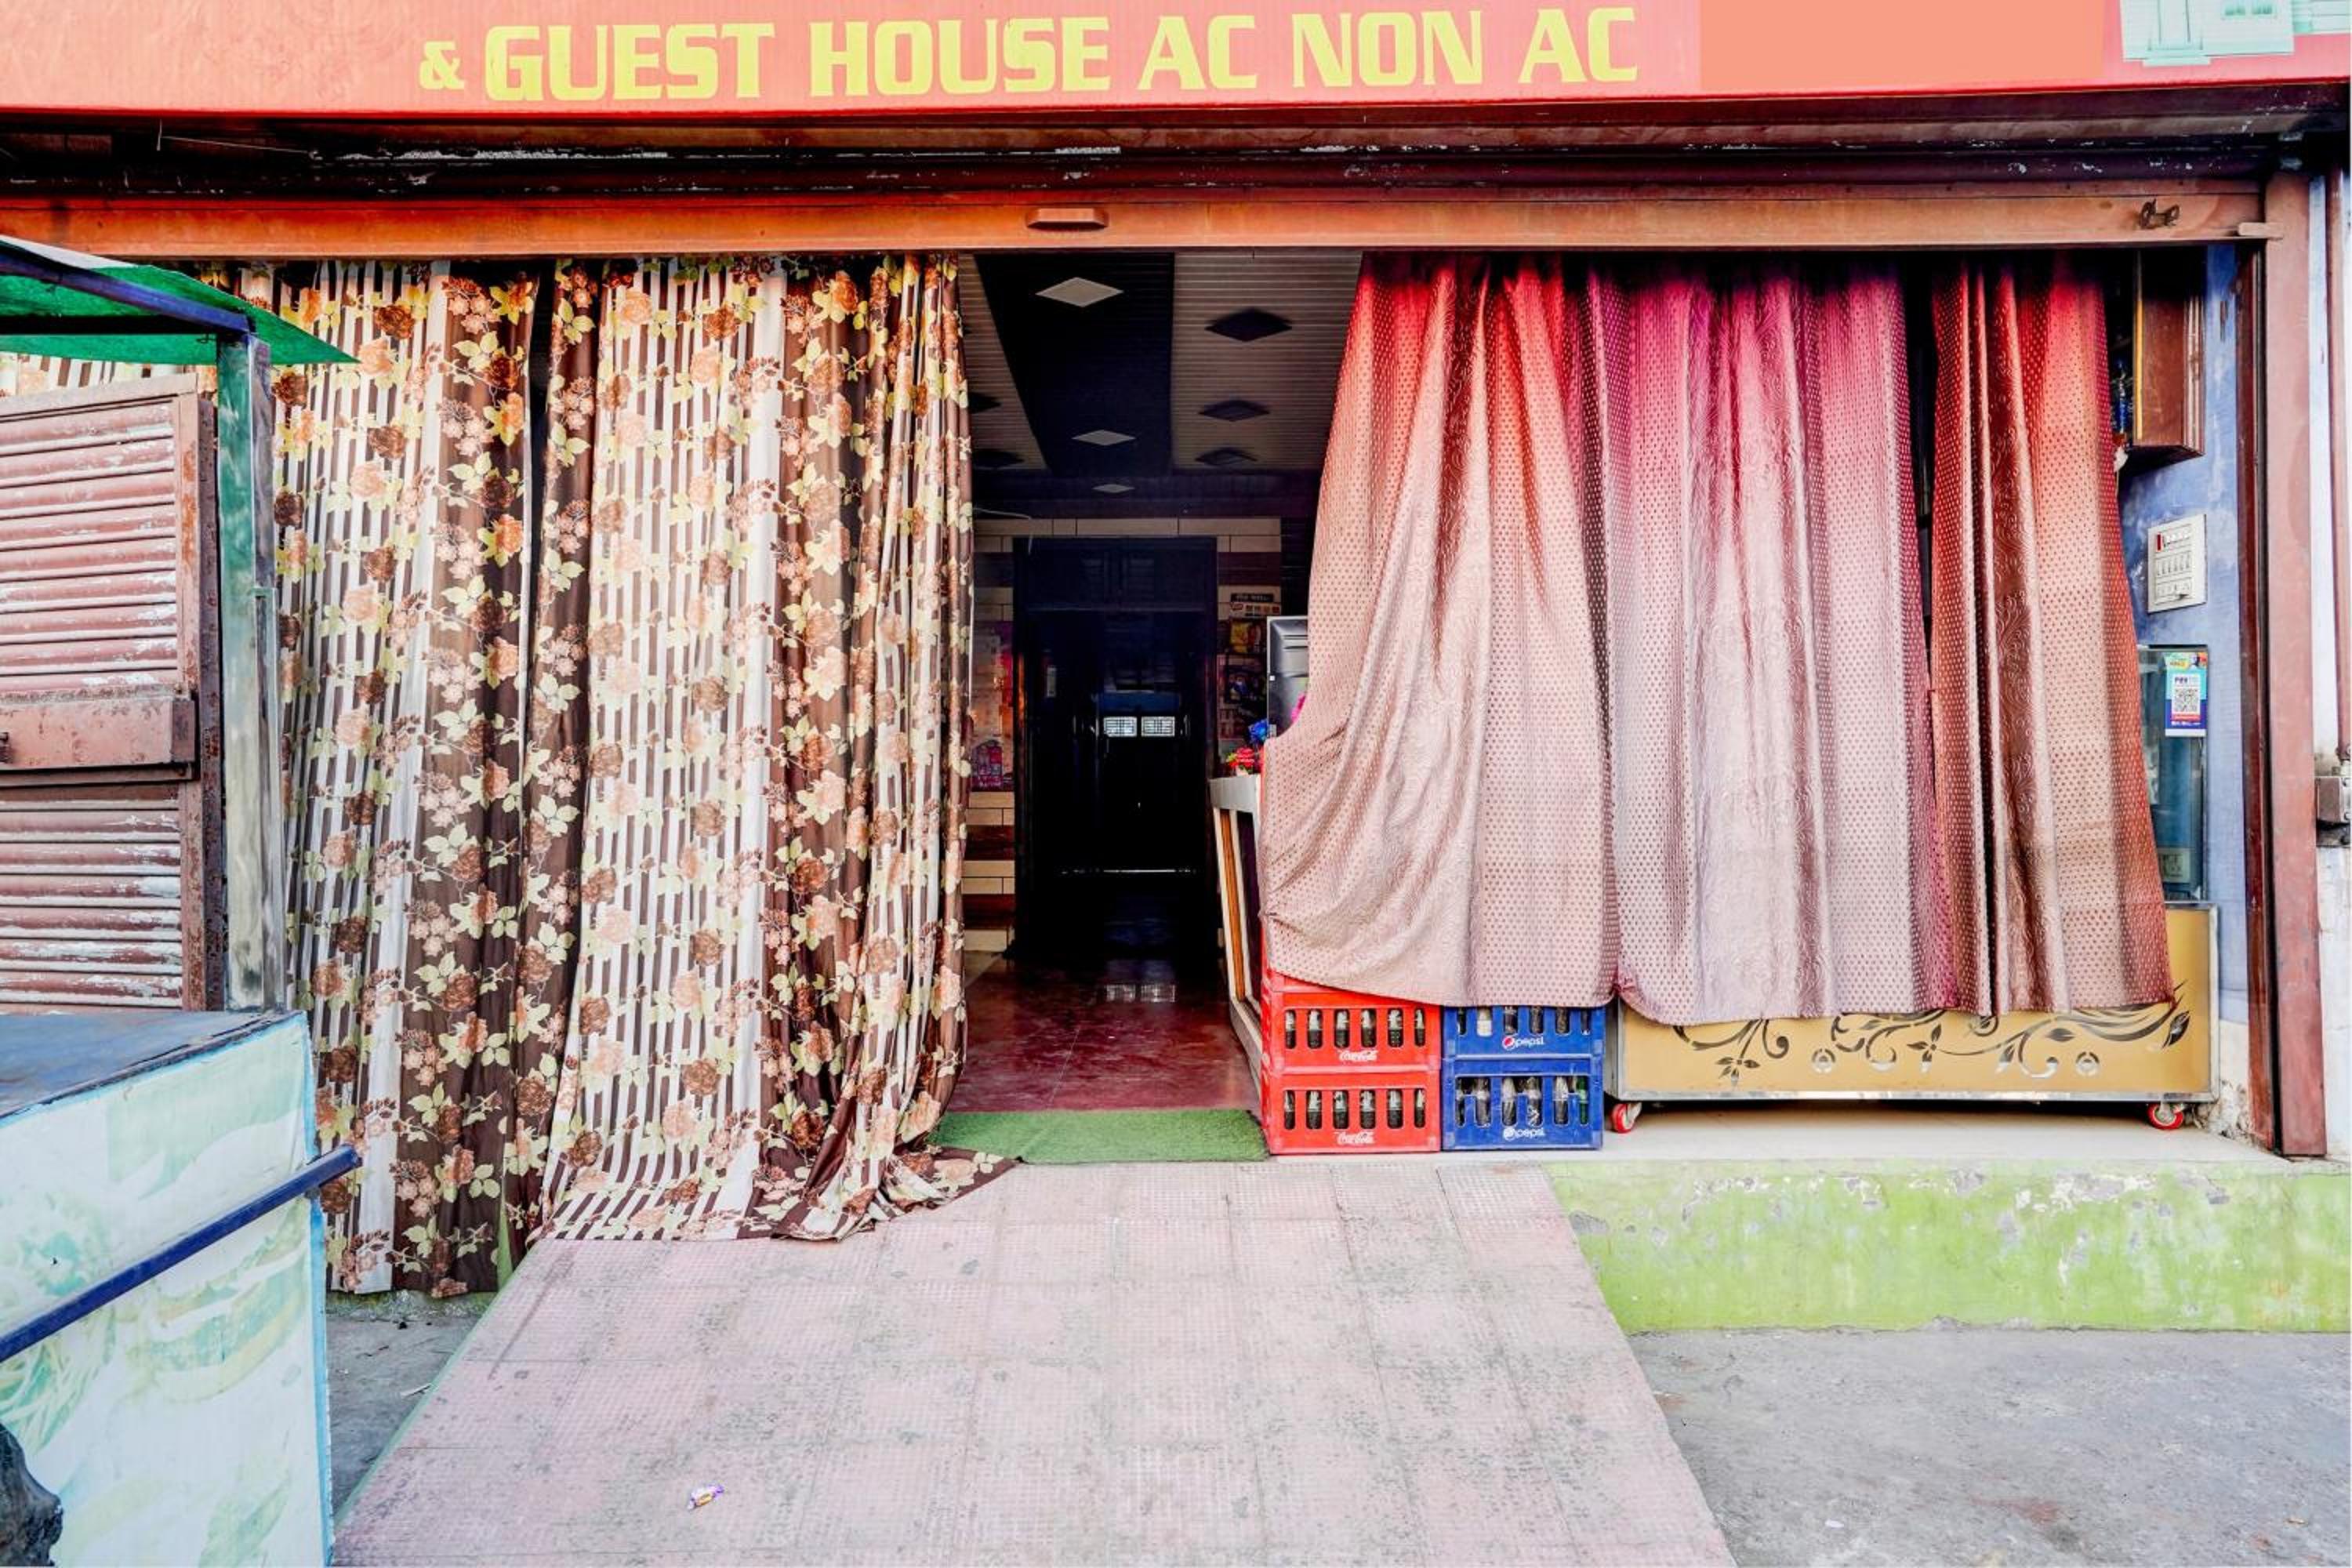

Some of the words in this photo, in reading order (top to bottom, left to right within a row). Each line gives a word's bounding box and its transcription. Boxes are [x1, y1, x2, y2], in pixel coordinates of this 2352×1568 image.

[418, 40, 465, 90] &
[484, 23, 775, 101] GUEST
[810, 16, 1111, 97] HOUSE
[1139, 15, 1258, 91] AC
[1292, 10, 1483, 88] NON
[1519, 8, 1638, 83] AC
